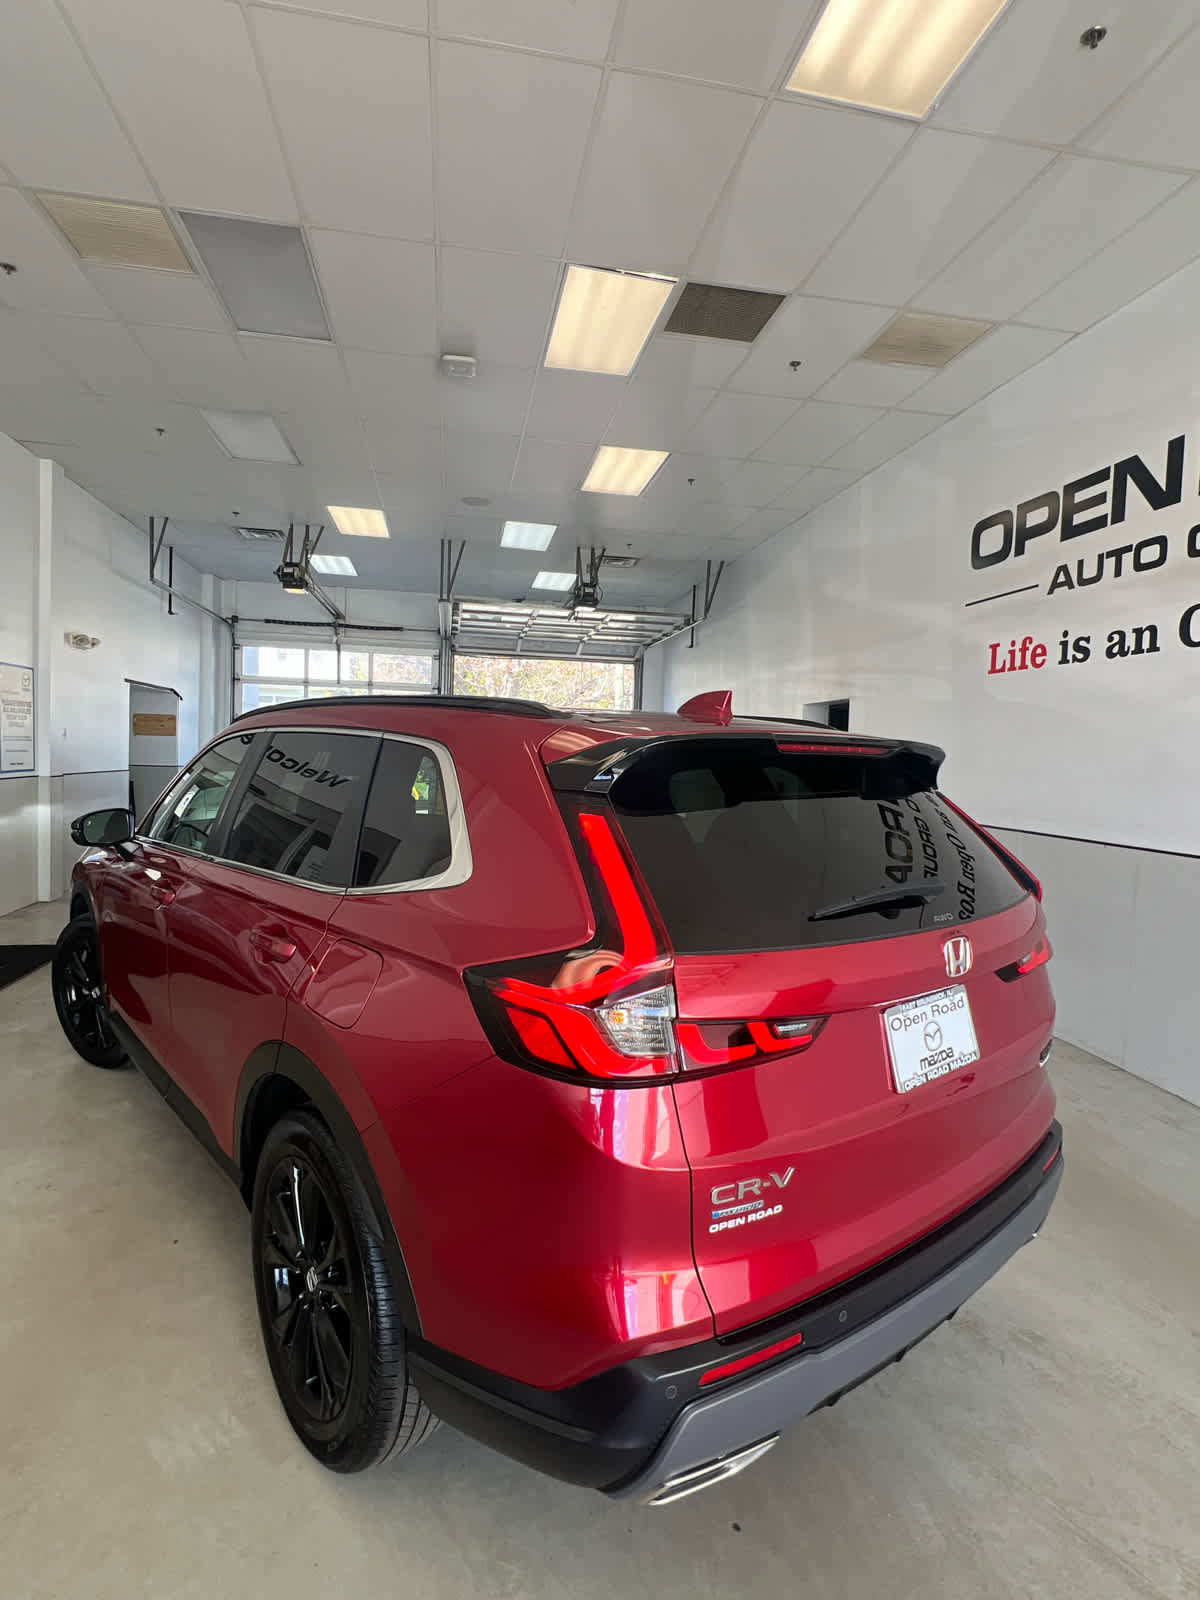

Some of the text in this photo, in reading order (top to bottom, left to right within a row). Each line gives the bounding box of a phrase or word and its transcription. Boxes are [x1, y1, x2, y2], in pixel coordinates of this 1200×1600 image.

[971, 434, 1185, 570] OPEN
[1047, 535, 1168, 596] AUTO
[988, 636, 1047, 674] Life
[1058, 630, 1091, 665] is
[1105, 624, 1160, 659] an
[891, 1012, 927, 1031] Open
[931, 995, 965, 1018] Road
[711, 1166, 795, 1205] CR-V
[709, 1216, 746, 1234] OPEN
[747, 1204, 783, 1223] ROAD
